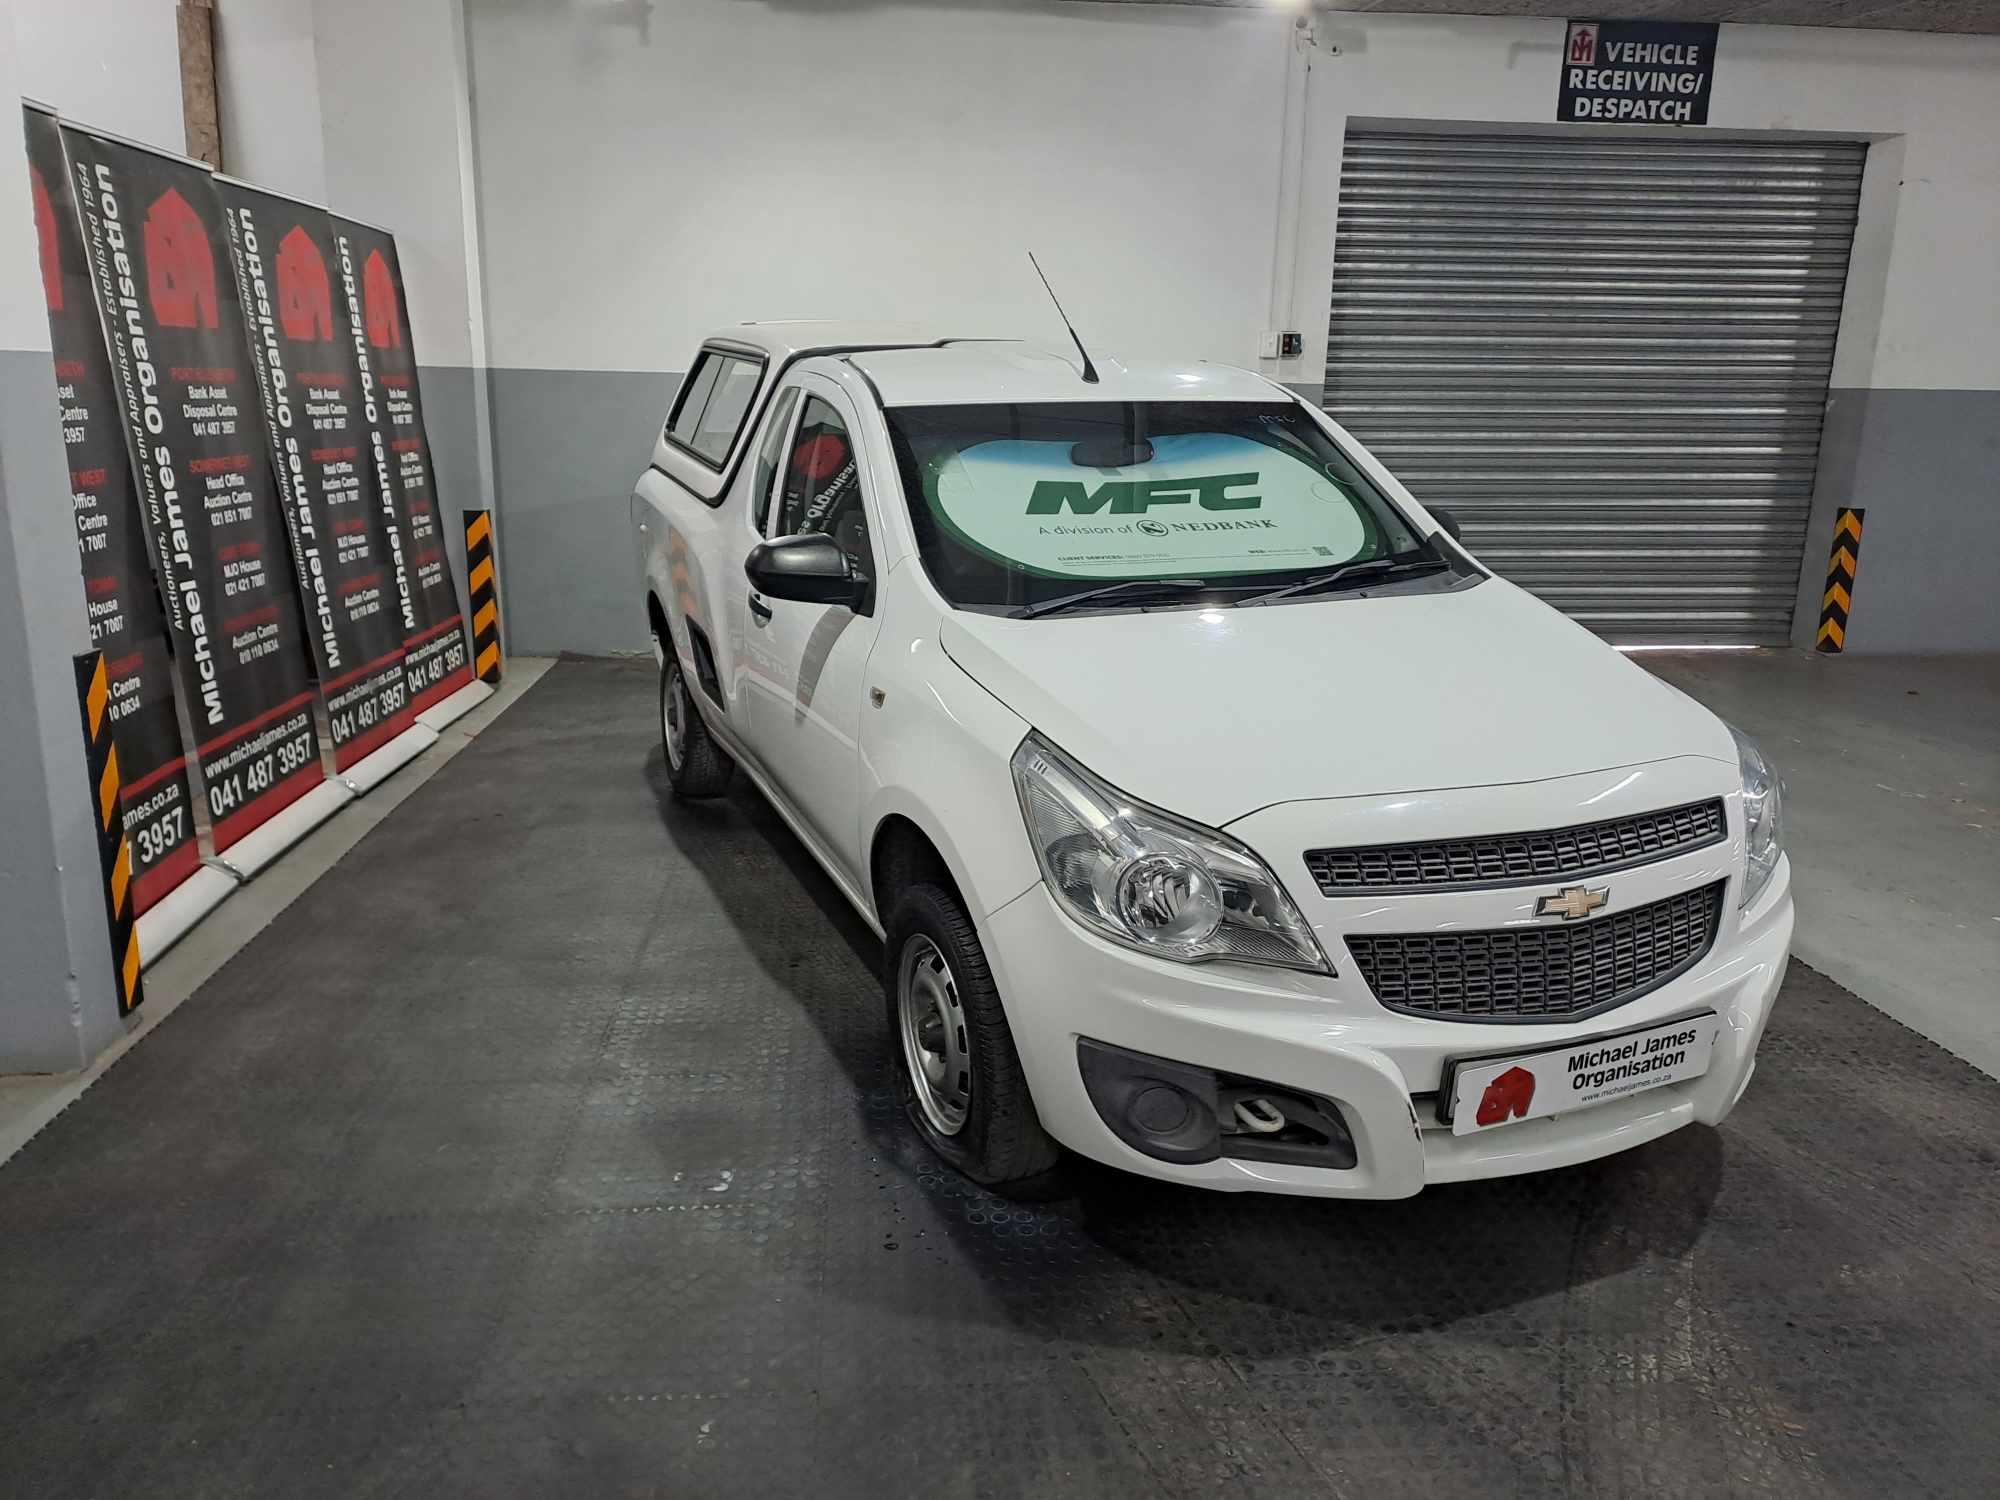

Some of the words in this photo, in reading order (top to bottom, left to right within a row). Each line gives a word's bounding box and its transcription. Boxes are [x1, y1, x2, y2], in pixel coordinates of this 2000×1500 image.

[1605, 41, 1699, 66] VEHICLE
[1568, 68, 1704, 95] RECEIVING/
[1574, 97, 1692, 121] DESPATCH
[76, 161, 95, 207] 1964
[95, 163, 163, 435] Organisation
[239, 207, 293, 429] Organisation
[113, 330, 141, 423] Appraisers
[64, 426, 85, 444] 3957
[131, 425, 148, 459] and
[142, 463, 162, 525] Valuers
[285, 437, 316, 540] James
[371, 430, 396, 519] James
[1025, 471, 1263, 515] MFC
[78, 513, 108, 531] Centre
[155, 446, 193, 571] James
[1039, 526, 1050, 536] A
[1054, 525, 1114, 536] division
[1119, 524, 1132, 535] of
[1170, 519, 1280, 532] NEDBANK
[386, 526, 416, 629] Michael
[88, 599, 118, 618] House
[90, 623, 102, 640] 21
[305, 548, 341, 669] Michael
[179, 579, 224, 725] Michael
[407, 665, 429, 693] 041
[428, 654, 444, 681] 487
[444, 643, 465, 671] 3957
[331, 709, 356, 744] 041
[358, 697, 379, 728] 487
[379, 681, 406, 716] 3957
[205, 713, 308, 779] www.michaeljames.co.za
[210, 773, 243, 816] 041
[247, 754, 274, 792] 487
[277, 732, 312, 774] 3957
[137, 805, 183, 863] 3957
[1567, 1040, 1638, 1073] Michael
[1641, 1029, 1697, 1055] James
[1572, 1050, 1686, 1090] Organisation
